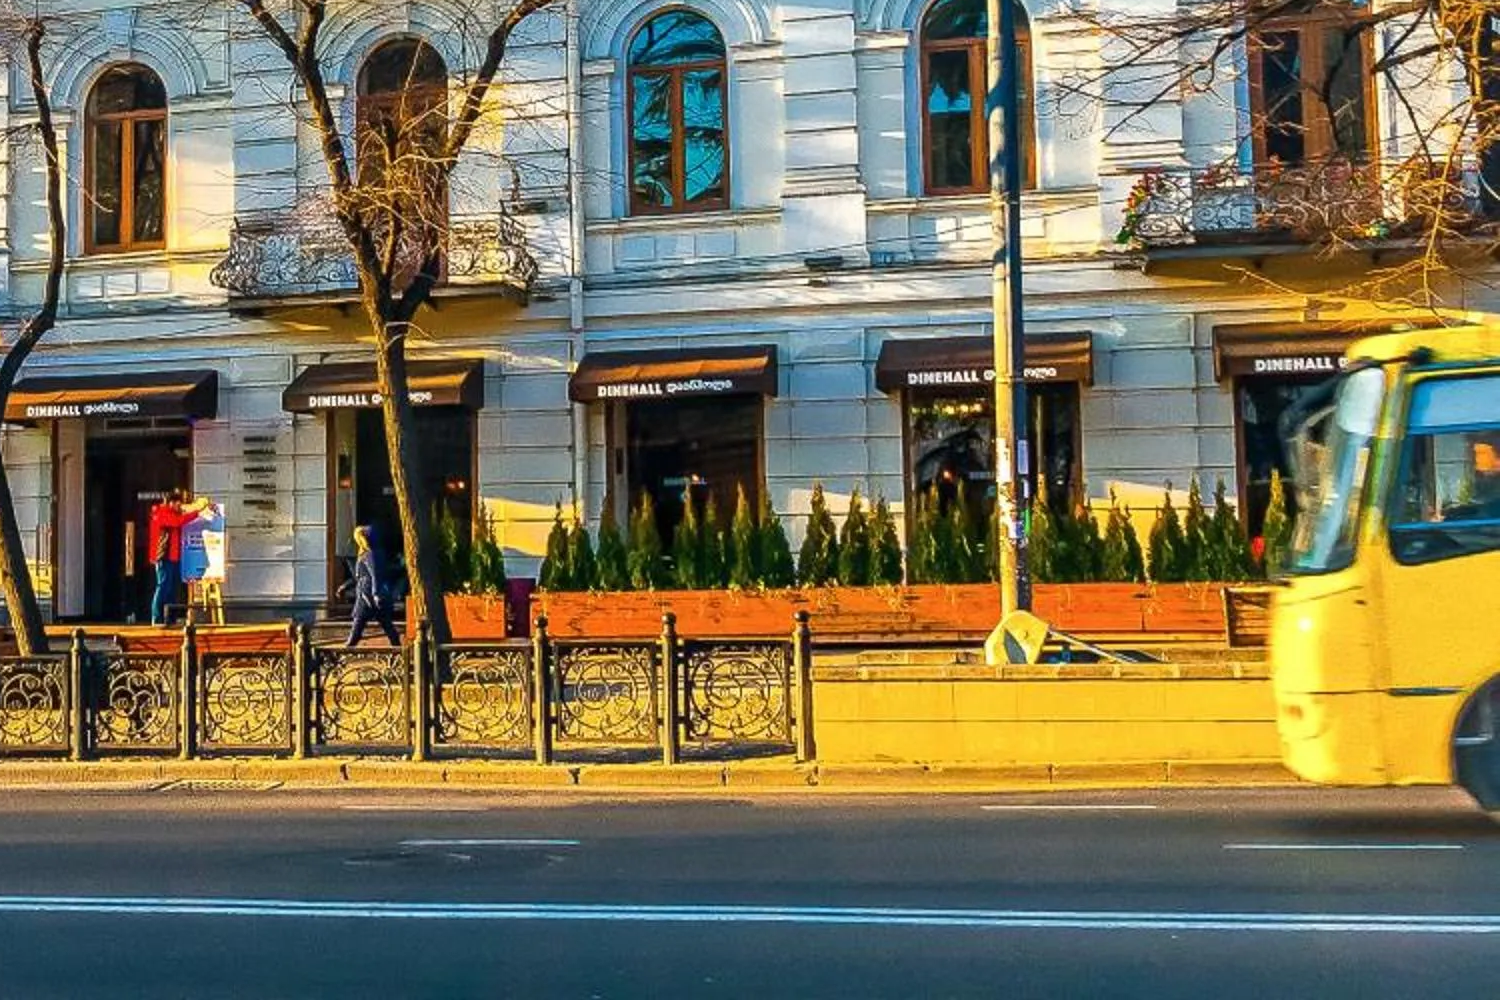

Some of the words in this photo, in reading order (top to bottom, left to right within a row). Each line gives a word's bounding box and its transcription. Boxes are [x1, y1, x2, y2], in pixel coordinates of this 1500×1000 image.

[1255, 357, 1334, 371] DINEHALL
[908, 370, 979, 385] DINEHALL
[597, 384, 663, 397] DINEHALL
[309, 394, 368, 408] DINEHALL
[27, 405, 81, 417] DINEHALL
